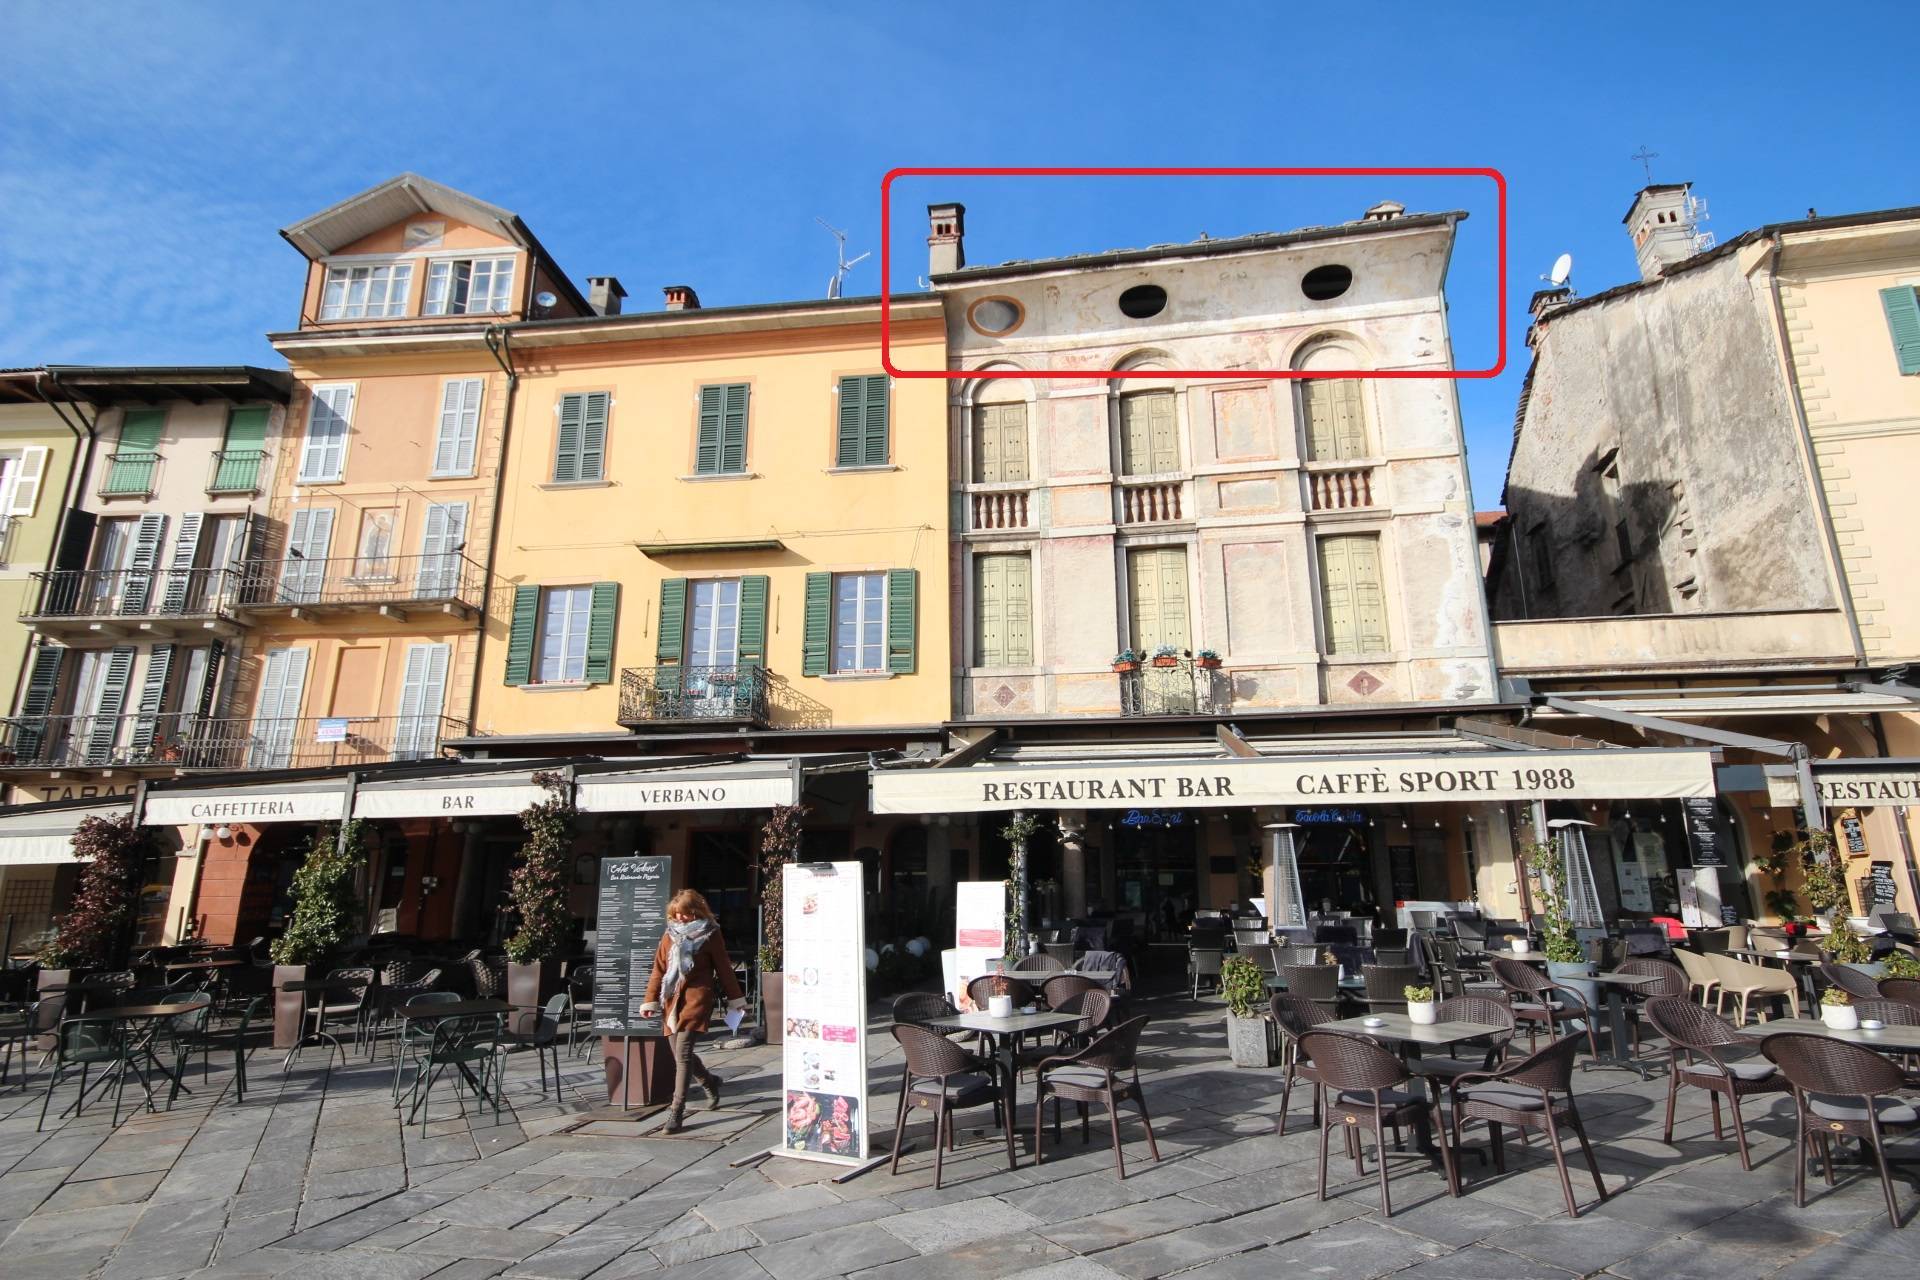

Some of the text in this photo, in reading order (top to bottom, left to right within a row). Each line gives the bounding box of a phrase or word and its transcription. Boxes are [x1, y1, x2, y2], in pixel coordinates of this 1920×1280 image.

[983, 776, 1235, 801] RESTAURANT BAR
[1296, 767, 1575, 794] CAFFÈ SPORT 1988
[442, 795, 475, 809] BAR
[640, 787, 726, 804] VERBANO
[191, 801, 295, 818] CAFFETTERIA
